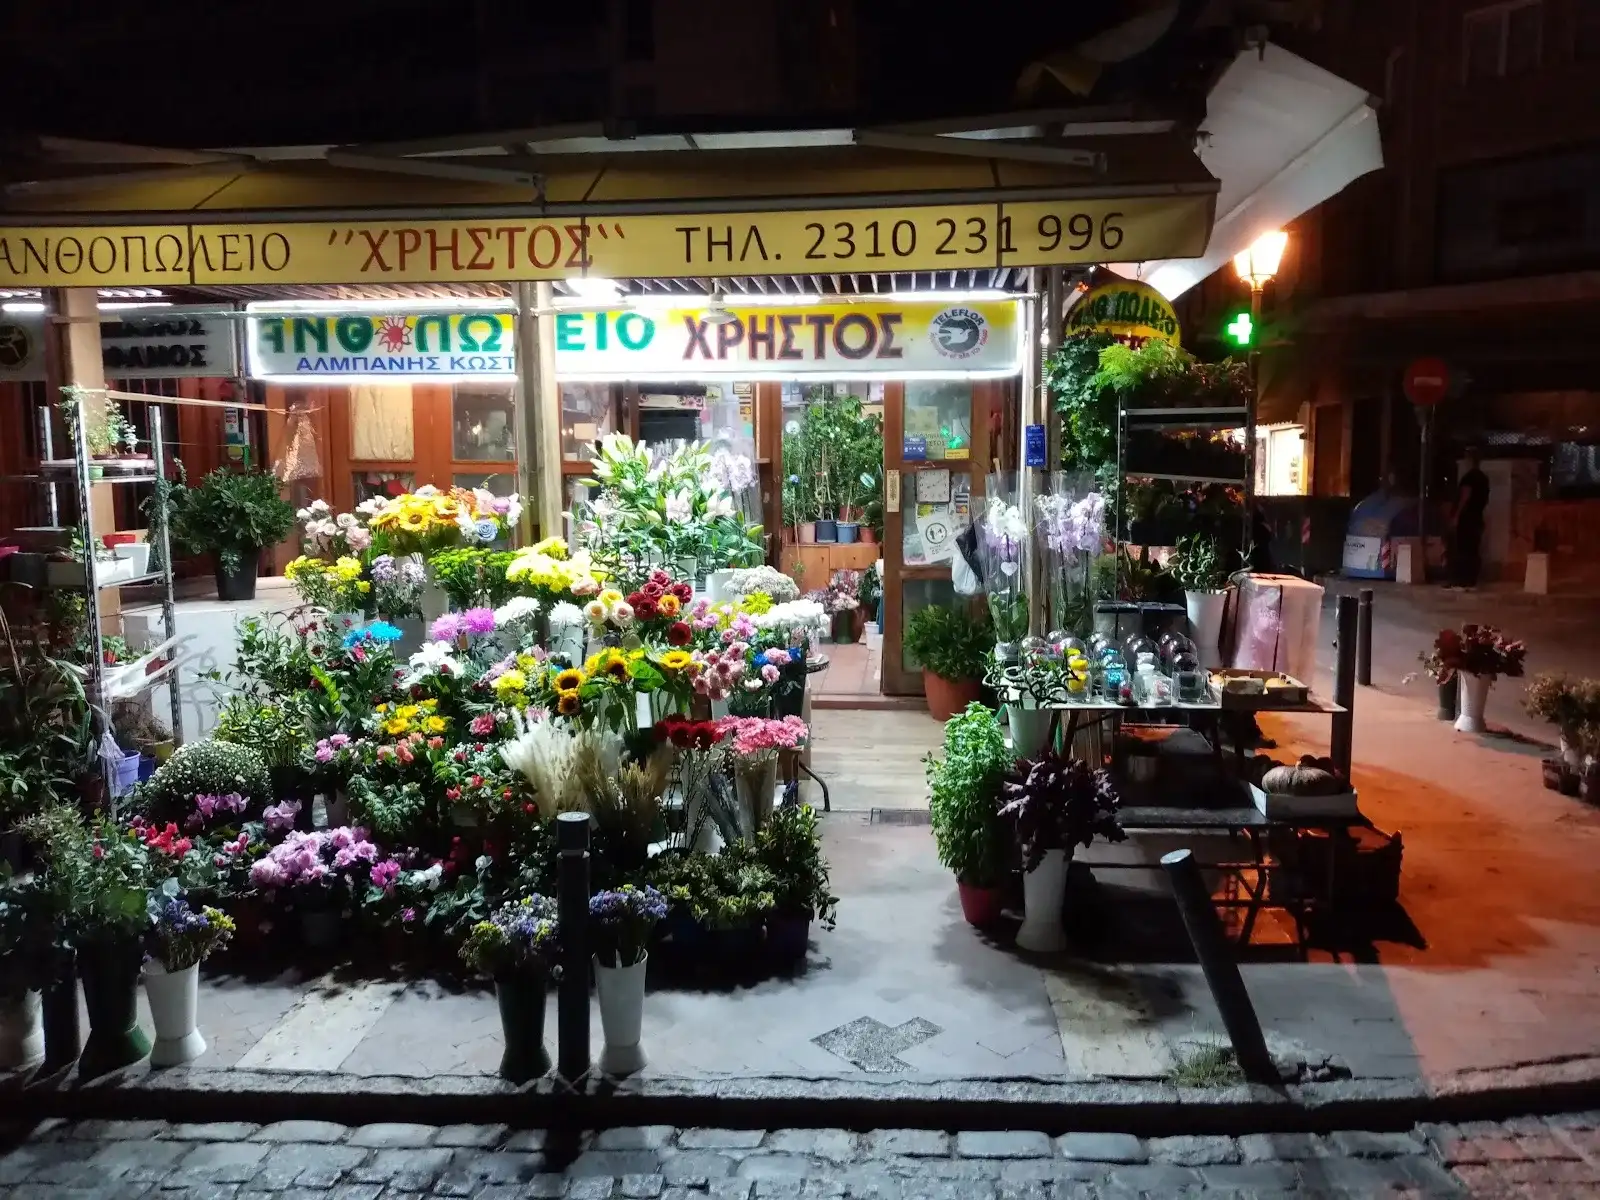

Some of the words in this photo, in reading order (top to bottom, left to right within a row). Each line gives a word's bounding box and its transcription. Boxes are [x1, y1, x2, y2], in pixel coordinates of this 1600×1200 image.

[676, 225, 782, 262] ΤΗΛ.
[804, 219, 917, 259] 2310
[935, 216, 1018, 254] 231
[1038, 212, 1123, 251] 996
[682, 312, 903, 360] ΧΡΗΣΤΟΣ
[296, 356, 440, 371] ΑΛΜΠΑΝΗΣ
[451, 356, 515, 370] ΚΩΣΤ
